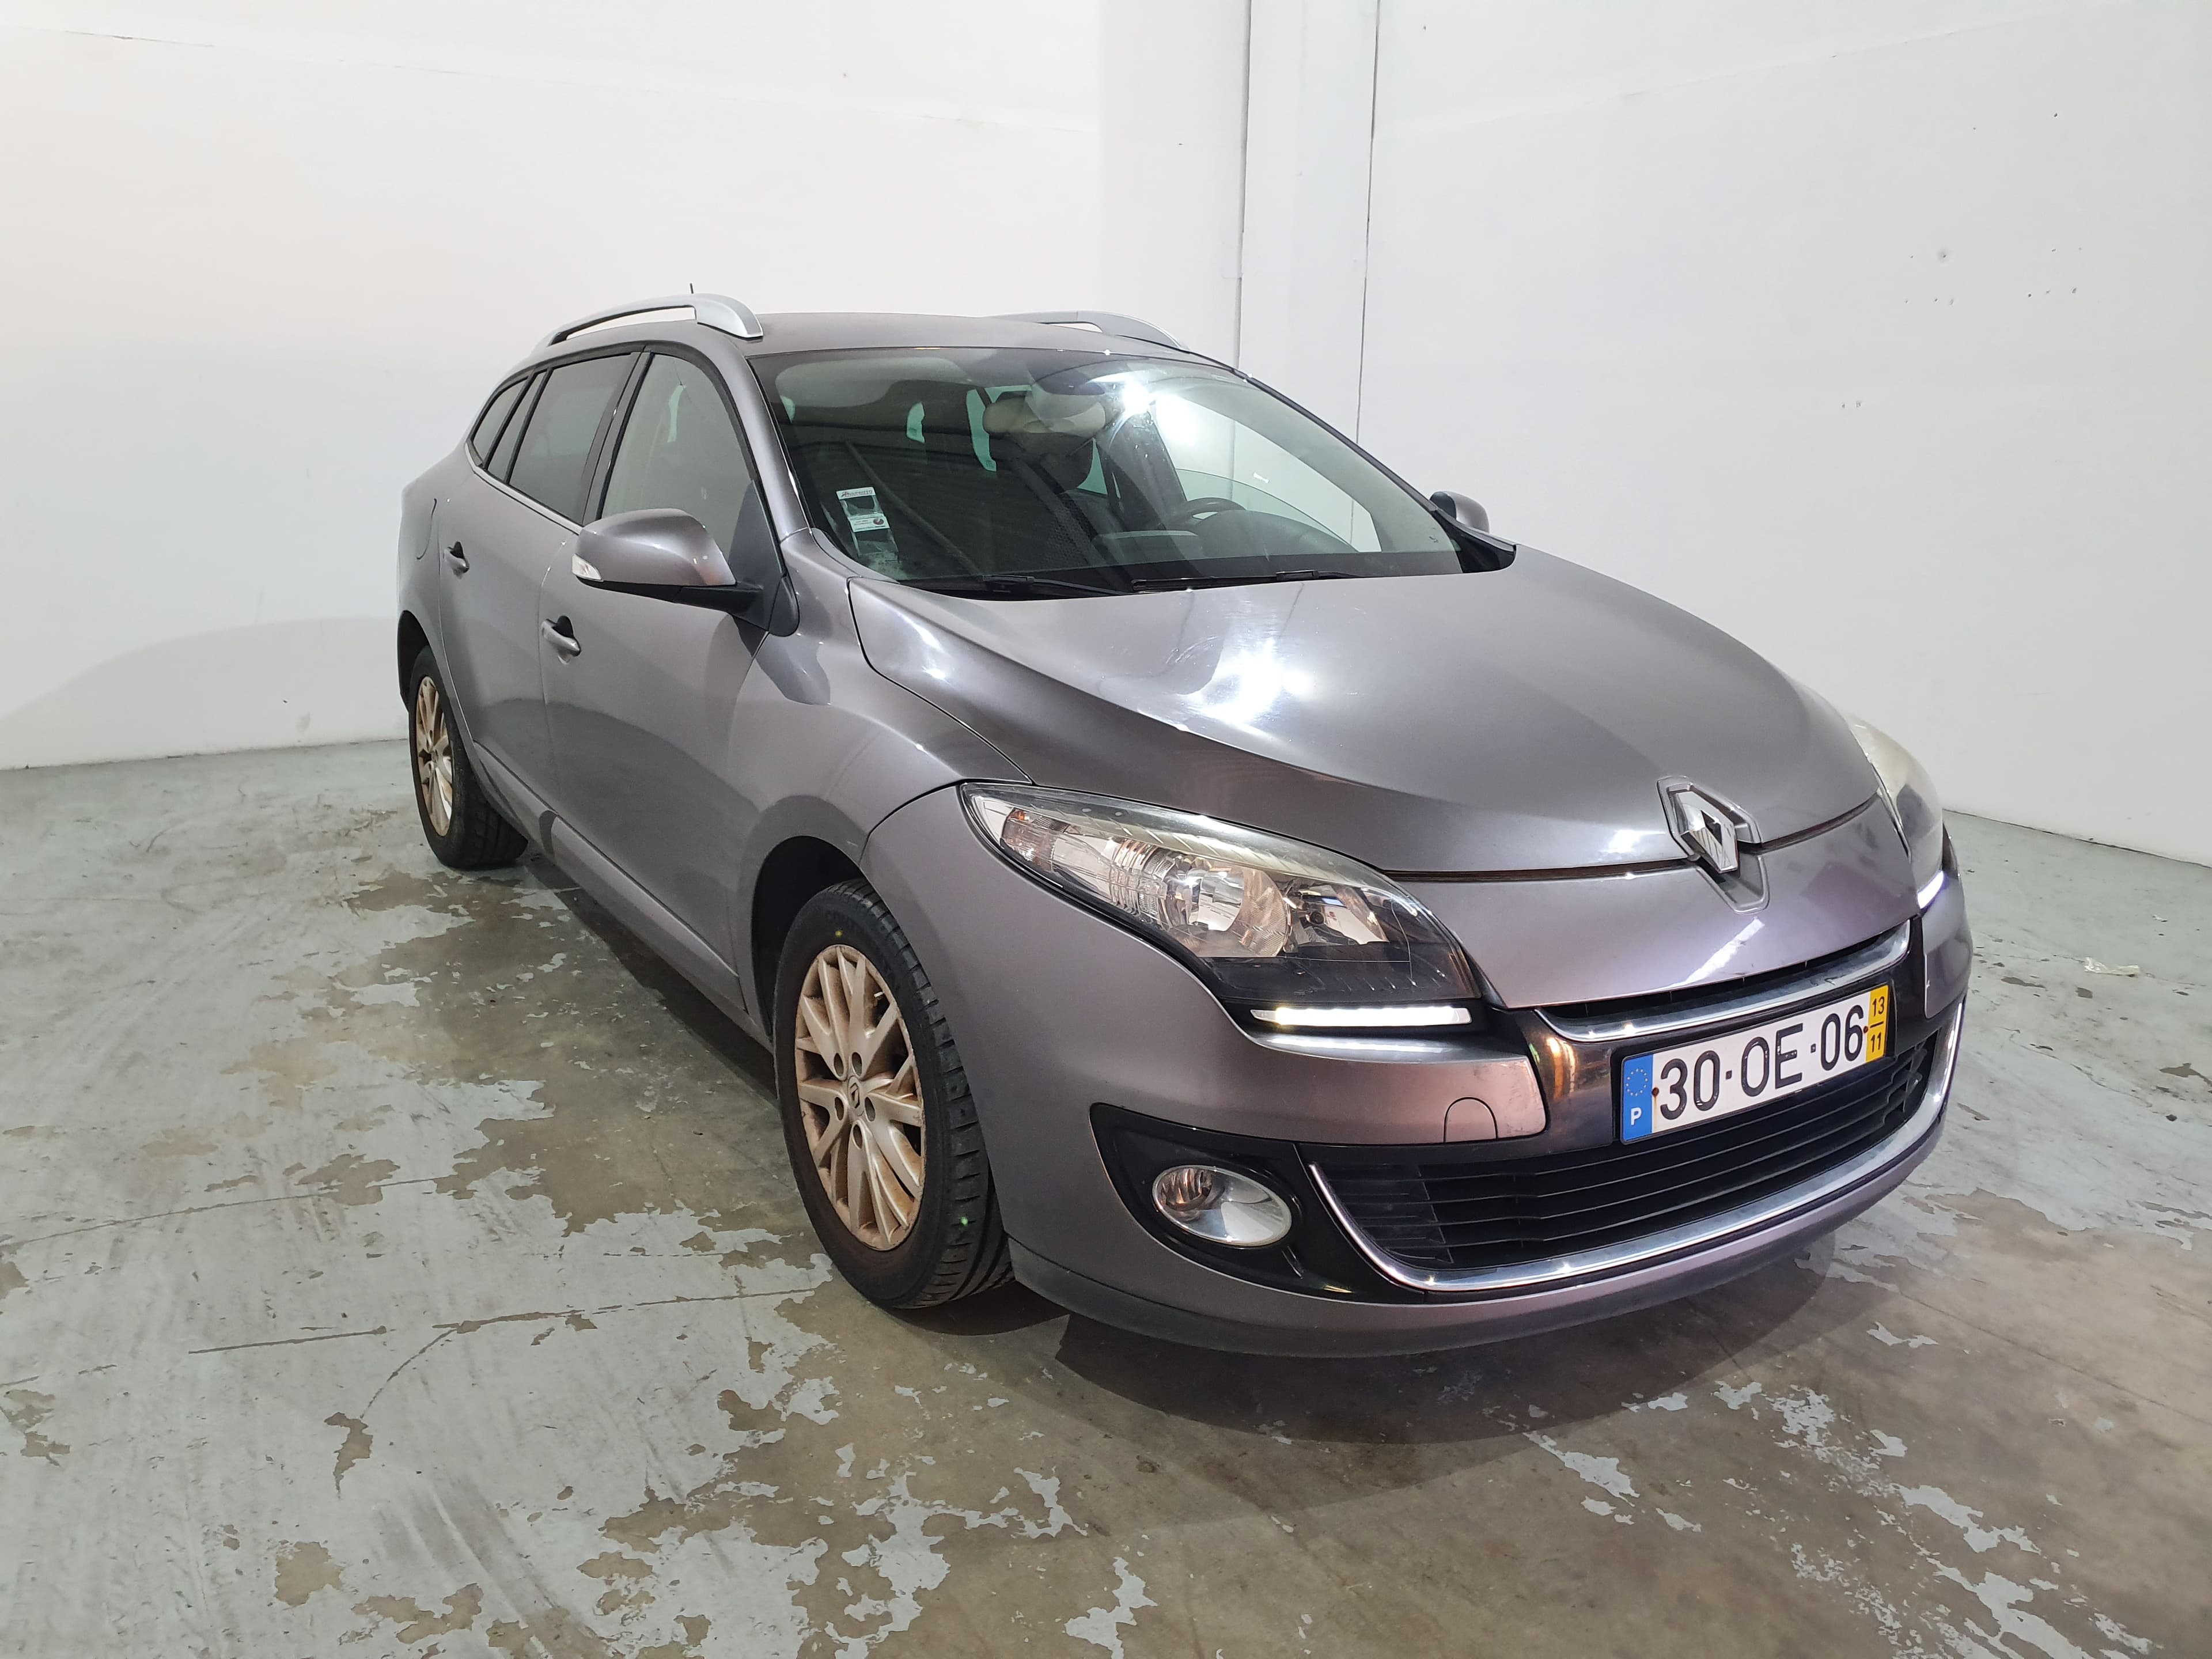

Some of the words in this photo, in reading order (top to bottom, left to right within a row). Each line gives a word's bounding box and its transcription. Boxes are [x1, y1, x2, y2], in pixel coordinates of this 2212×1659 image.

[1871, 996, 1885, 1018] 13
[1870, 1033, 1883, 1052] 11
[1630, 1107, 1642, 1126] P
